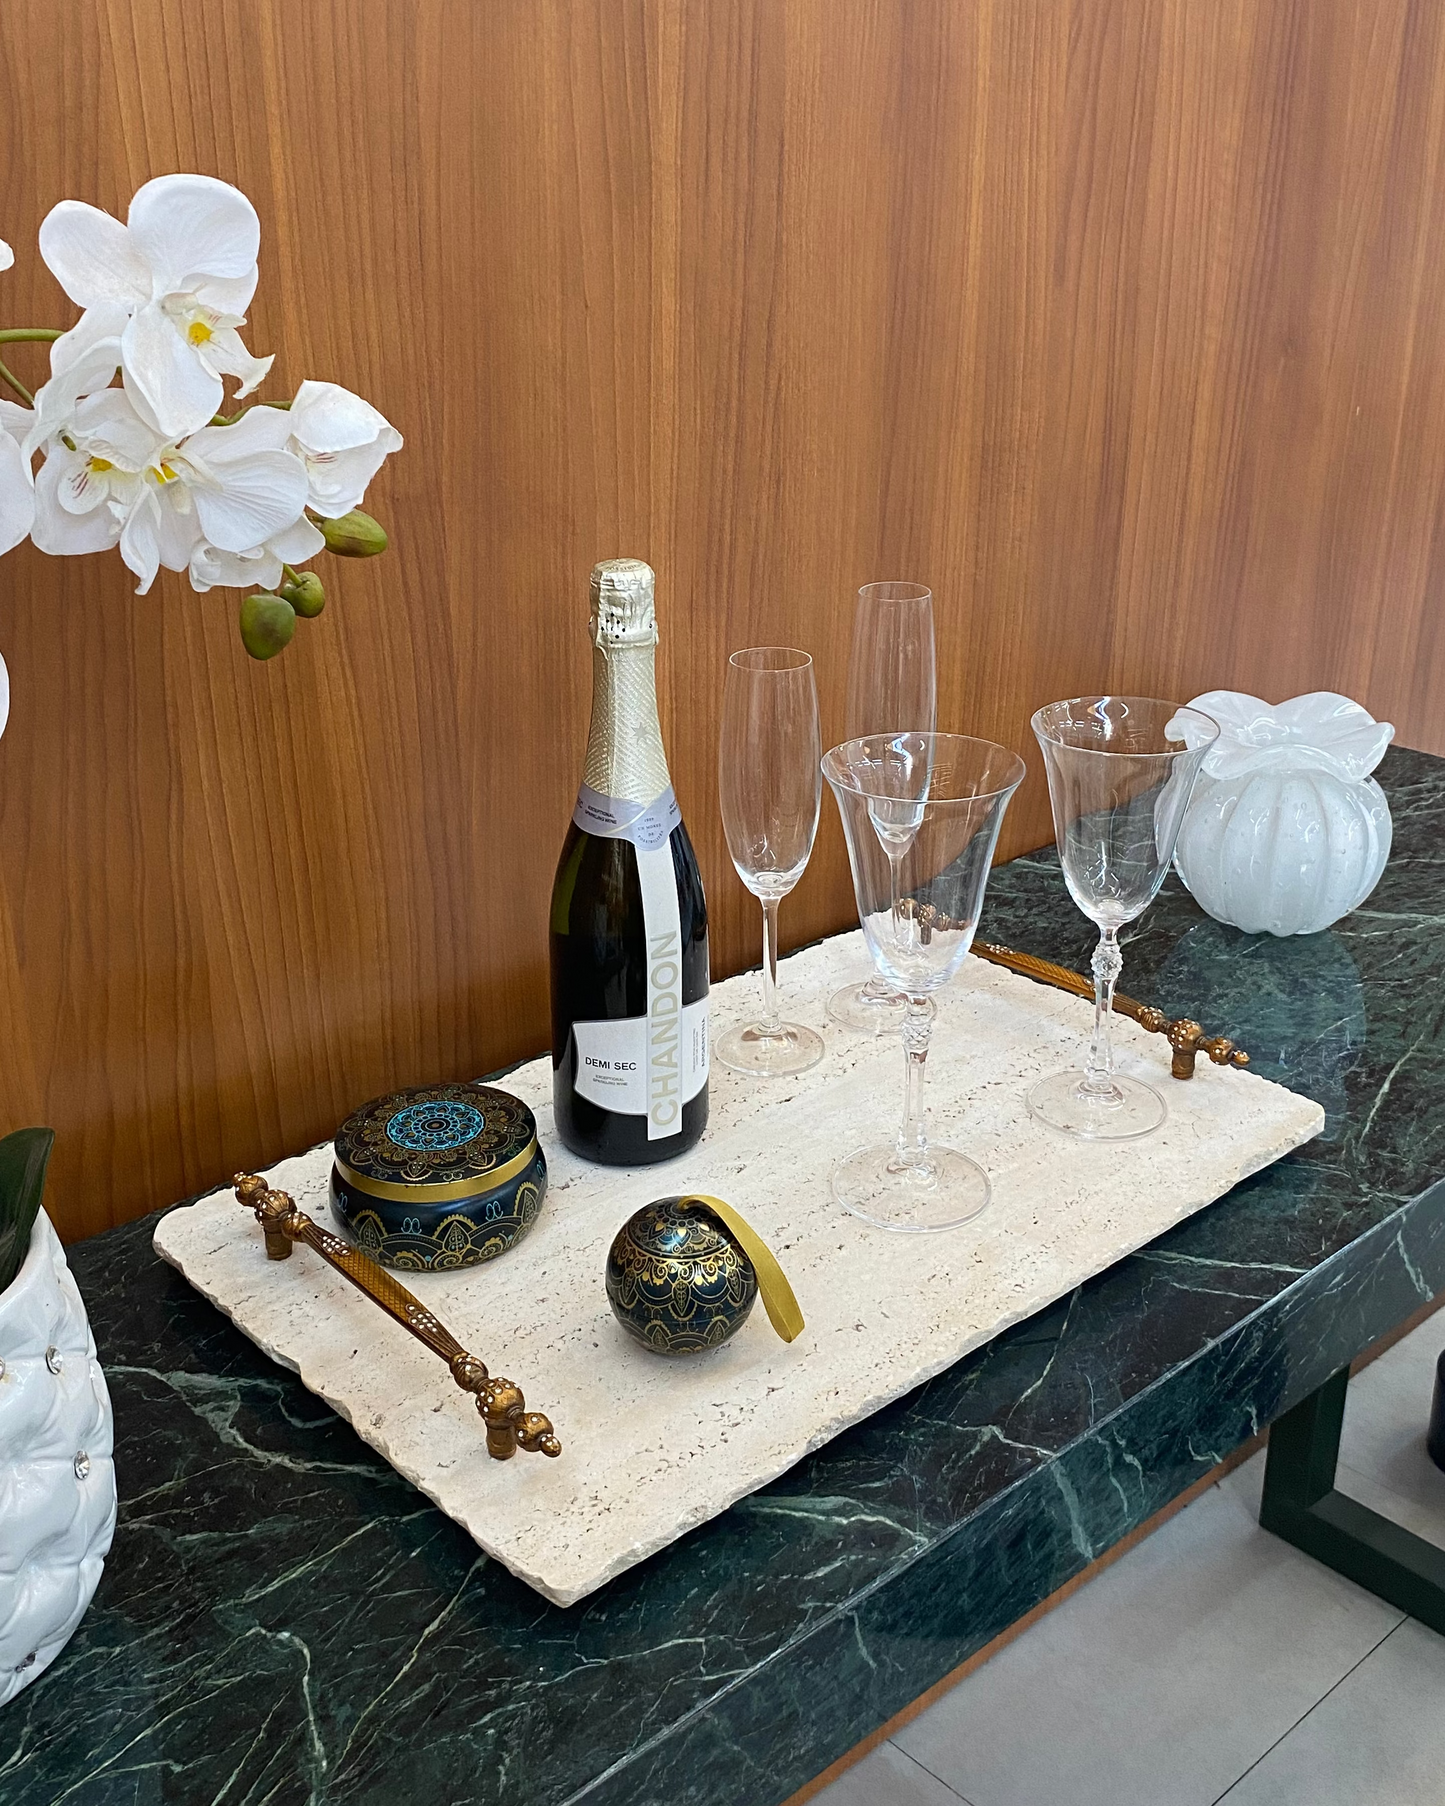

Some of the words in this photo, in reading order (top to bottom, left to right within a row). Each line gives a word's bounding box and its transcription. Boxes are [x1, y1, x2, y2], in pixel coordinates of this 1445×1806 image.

[585, 1056, 610, 1069] DEMI
[614, 1061, 637, 1071] SEC
[650, 930, 678, 1126] CHANDON
